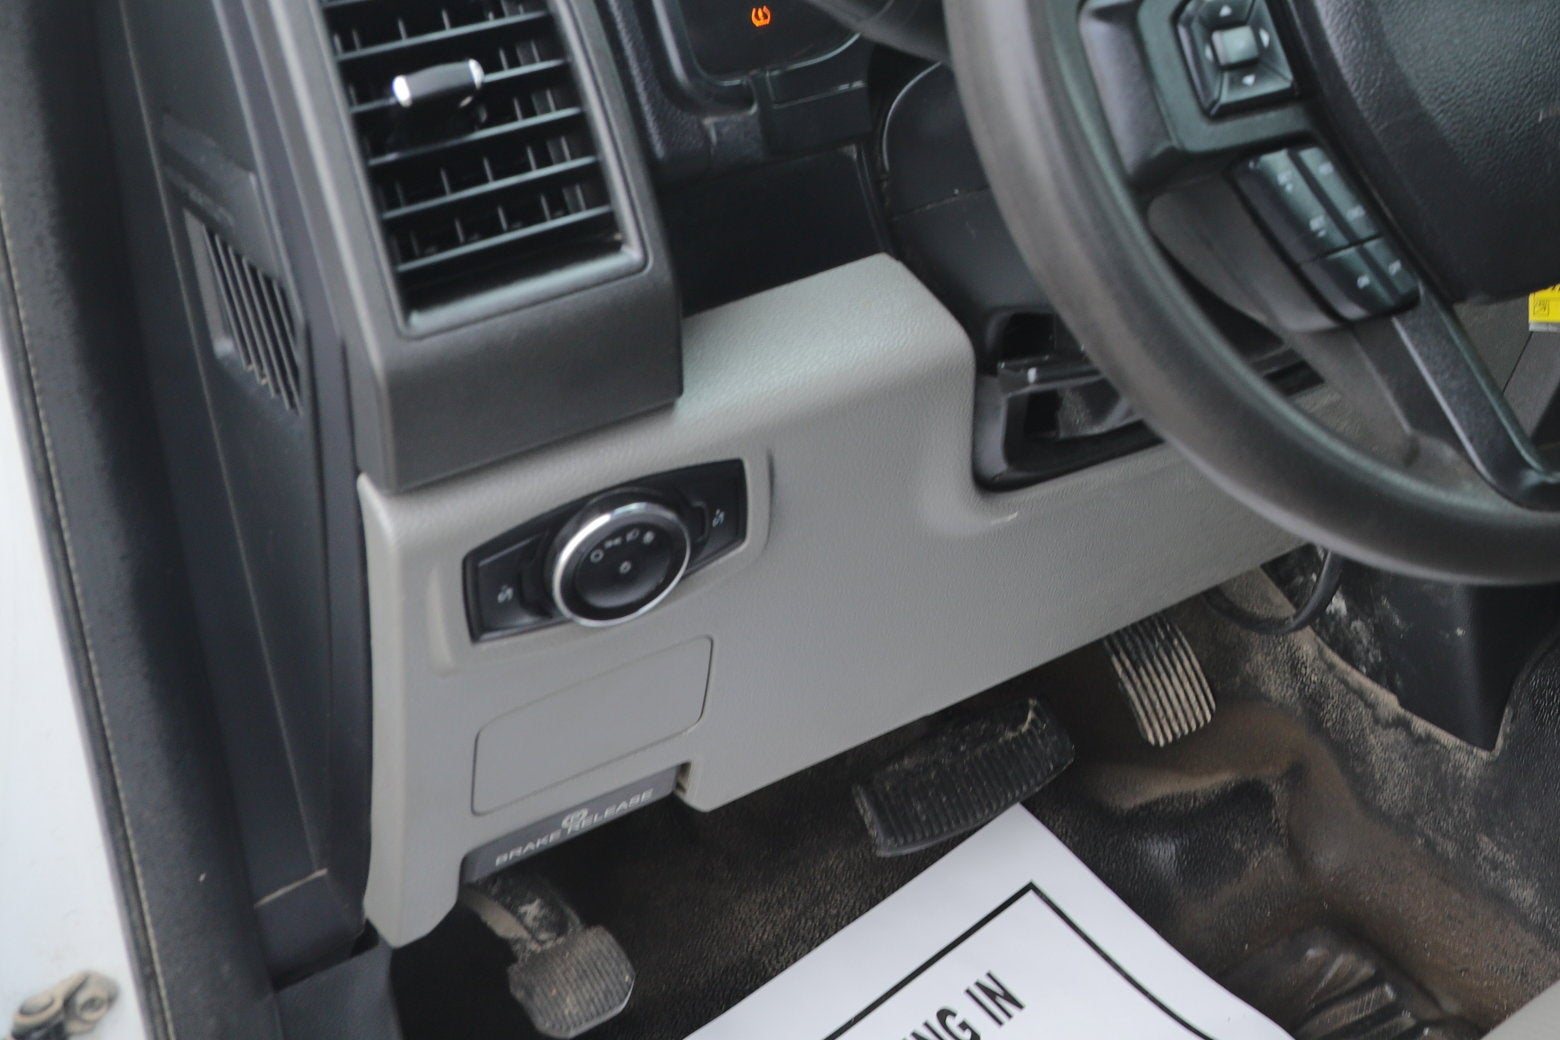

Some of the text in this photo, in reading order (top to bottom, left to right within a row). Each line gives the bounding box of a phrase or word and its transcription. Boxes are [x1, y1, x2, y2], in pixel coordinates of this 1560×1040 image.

[496, 788, 654, 866] BRAKE RELEASE
[965, 970, 1025, 1027] IN
